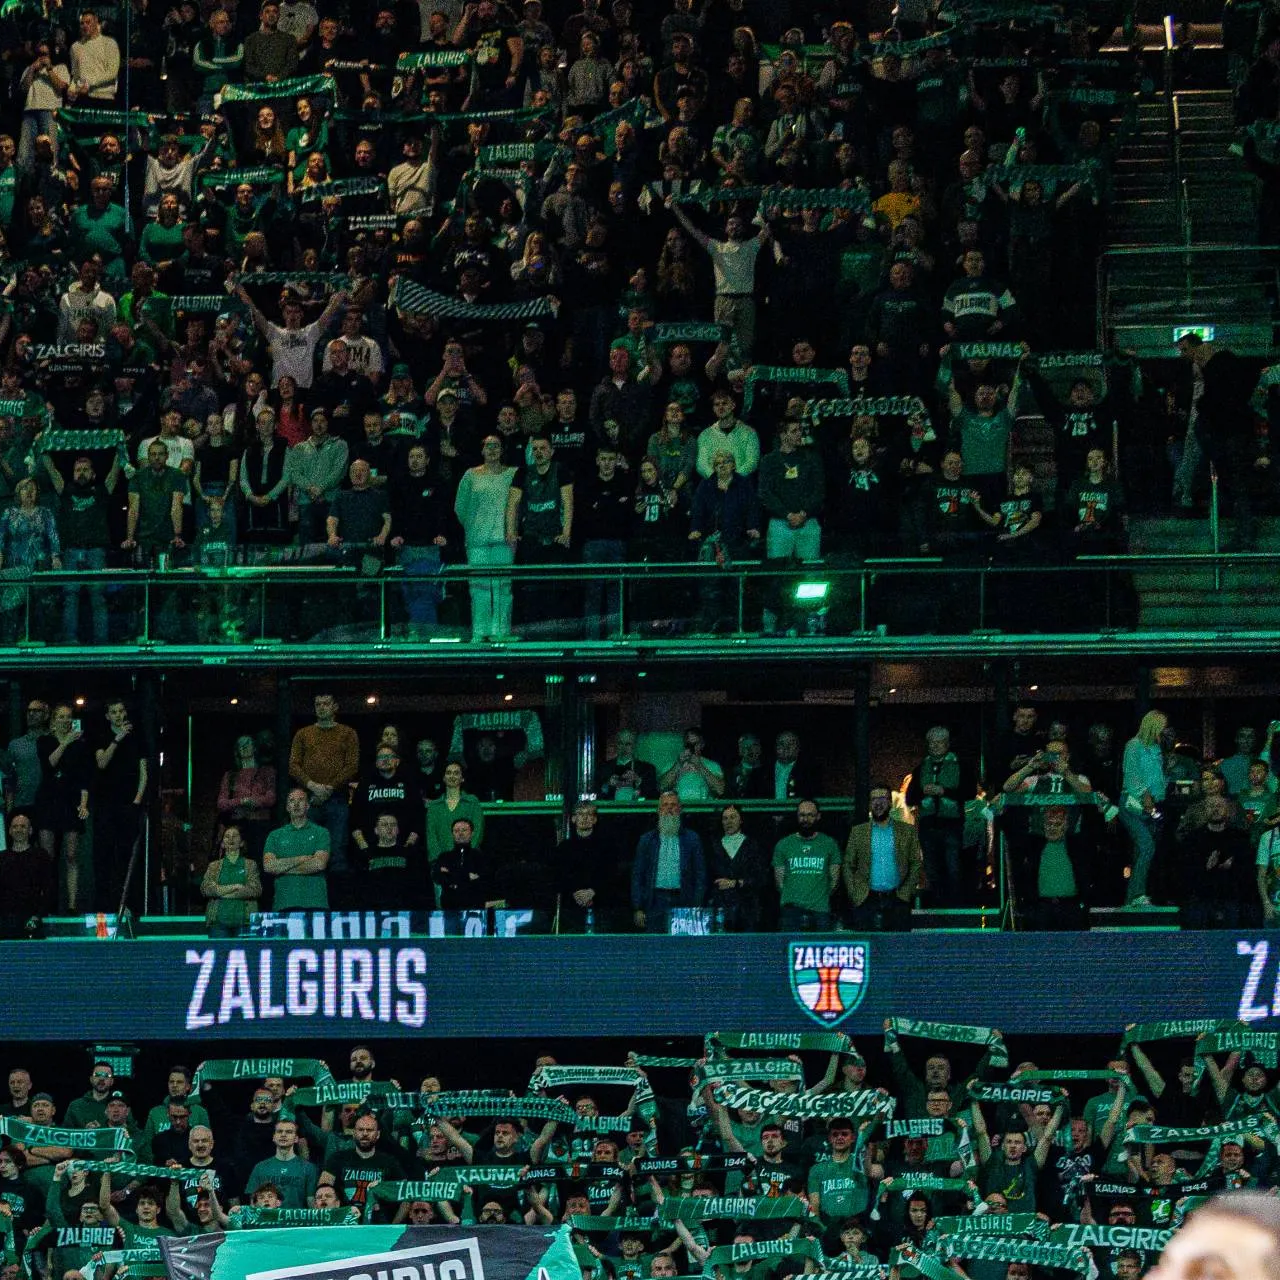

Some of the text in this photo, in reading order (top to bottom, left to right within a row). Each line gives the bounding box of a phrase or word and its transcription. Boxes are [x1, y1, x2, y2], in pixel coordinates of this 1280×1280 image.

[960, 344, 1021, 359] KAUNAS
[641, 1158, 746, 1170] KAUNAS 1944
[1095, 1183, 1208, 1193] KAUNAS 1944
